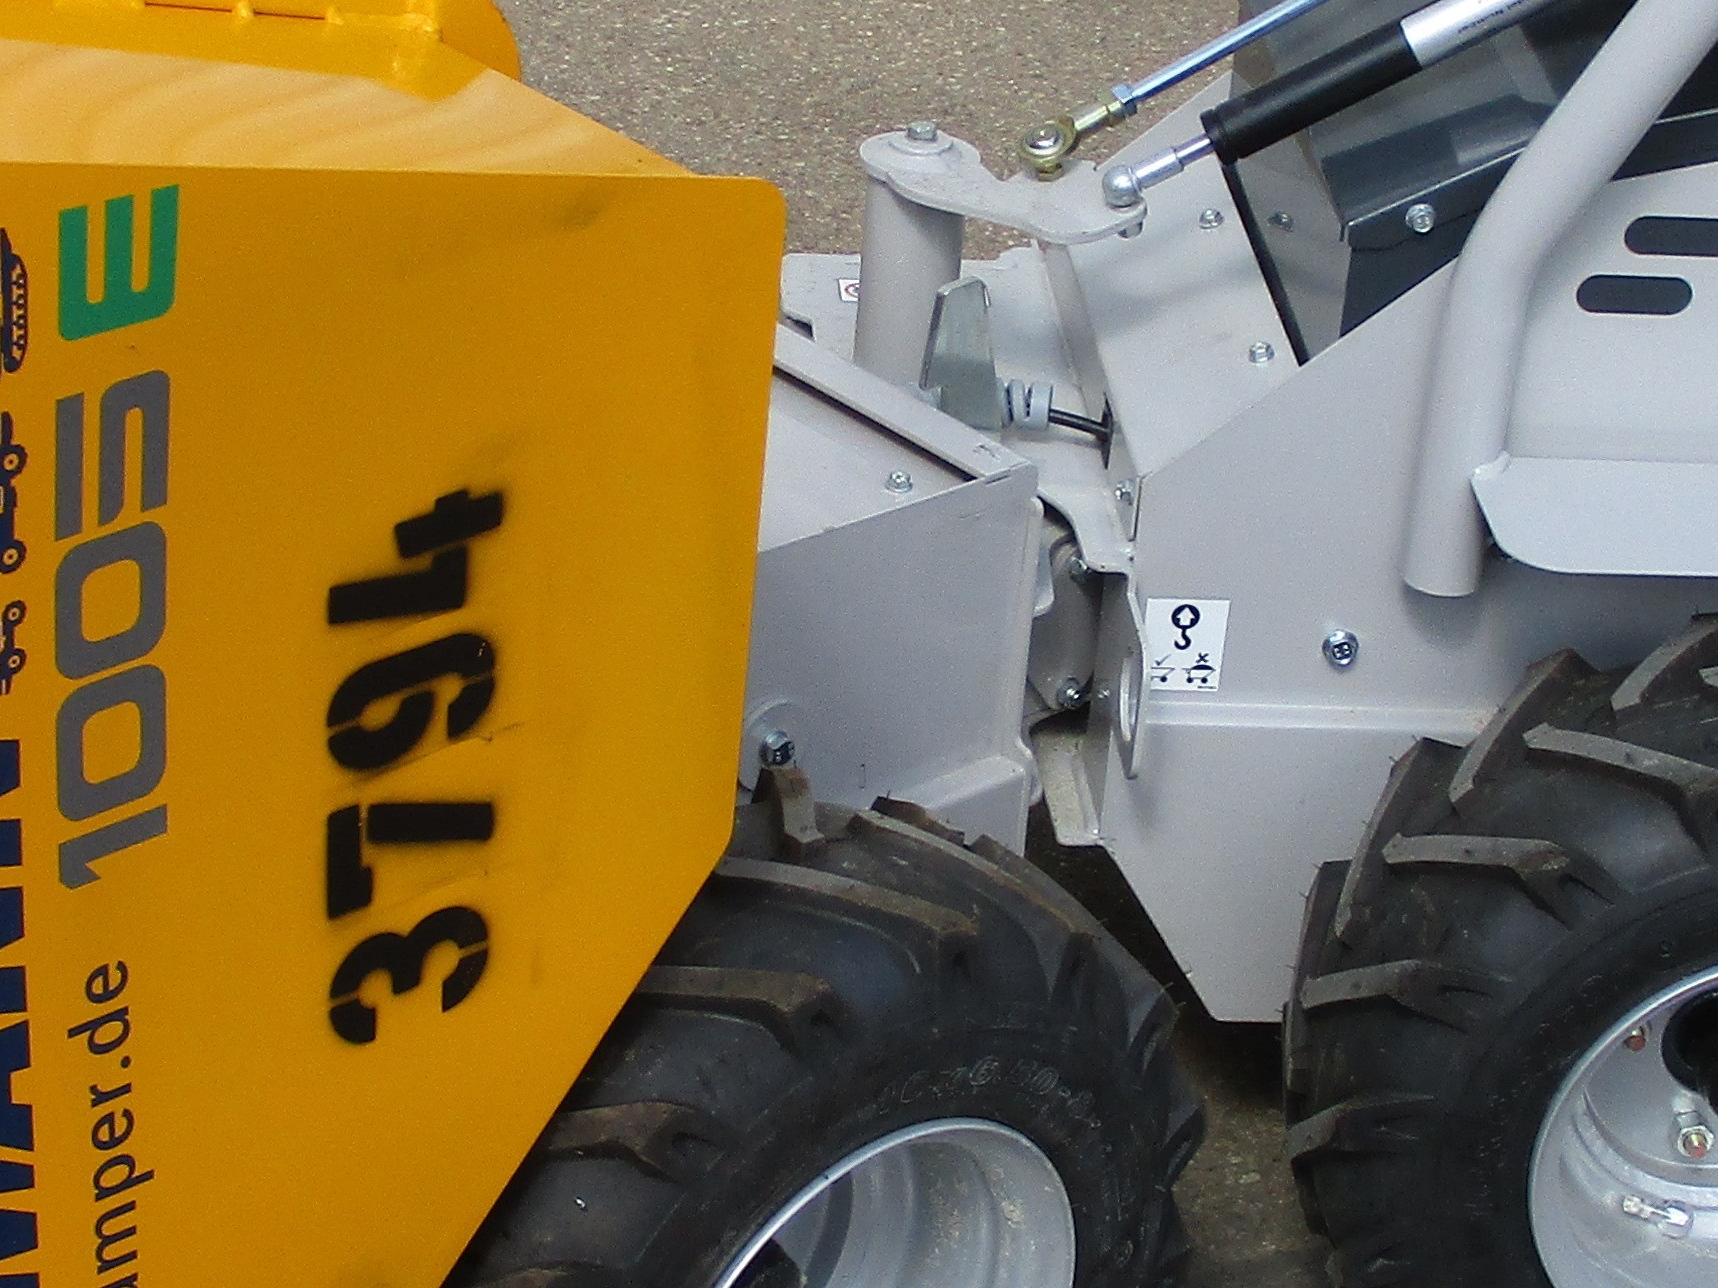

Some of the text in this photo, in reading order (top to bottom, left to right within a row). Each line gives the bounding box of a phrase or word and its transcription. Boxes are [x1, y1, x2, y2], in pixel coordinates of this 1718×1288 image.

[54, 184, 180, 890] 1005 E
[326, 488, 505, 1046] 3794
